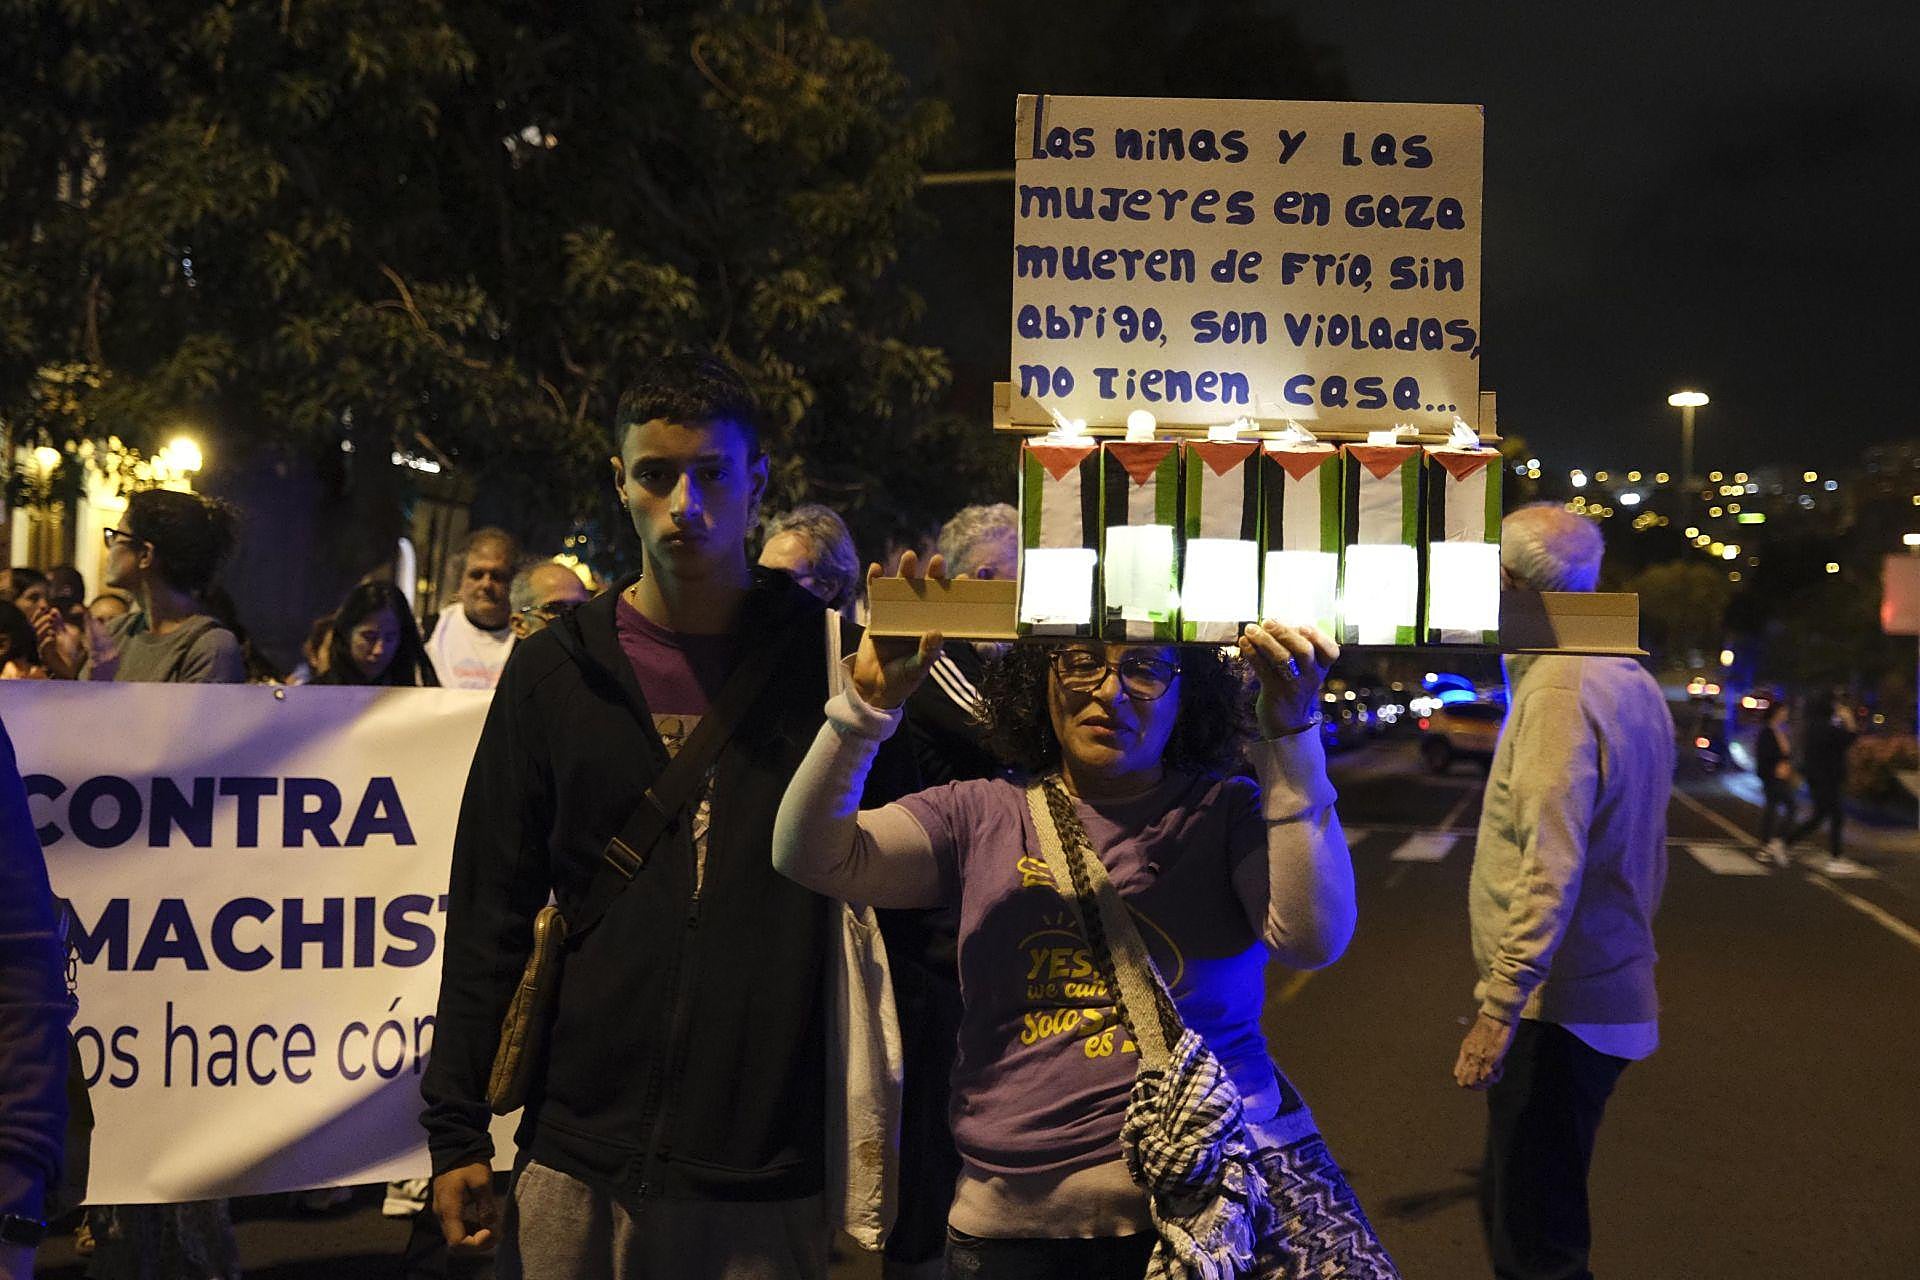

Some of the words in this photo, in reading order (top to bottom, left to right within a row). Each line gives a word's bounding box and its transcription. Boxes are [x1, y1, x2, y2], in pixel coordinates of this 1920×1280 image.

[1033, 96, 1095, 160] Las
[1274, 191, 1330, 226] en
[1345, 194, 1465, 230] Gaza
[1016, 244, 1195, 283] mueren
[1211, 249, 1262, 283] de
[1390, 256, 1464, 292] sin
[1018, 305, 1167, 347] abrigo,
[1191, 311, 1267, 344] son
[1019, 365, 1074, 398] no
[1284, 375, 1457, 411] casa...
[22, 774, 417, 849] CONTRA
[60, 894, 448, 971] MACHIS
[165, 1002, 316, 1087] hace
